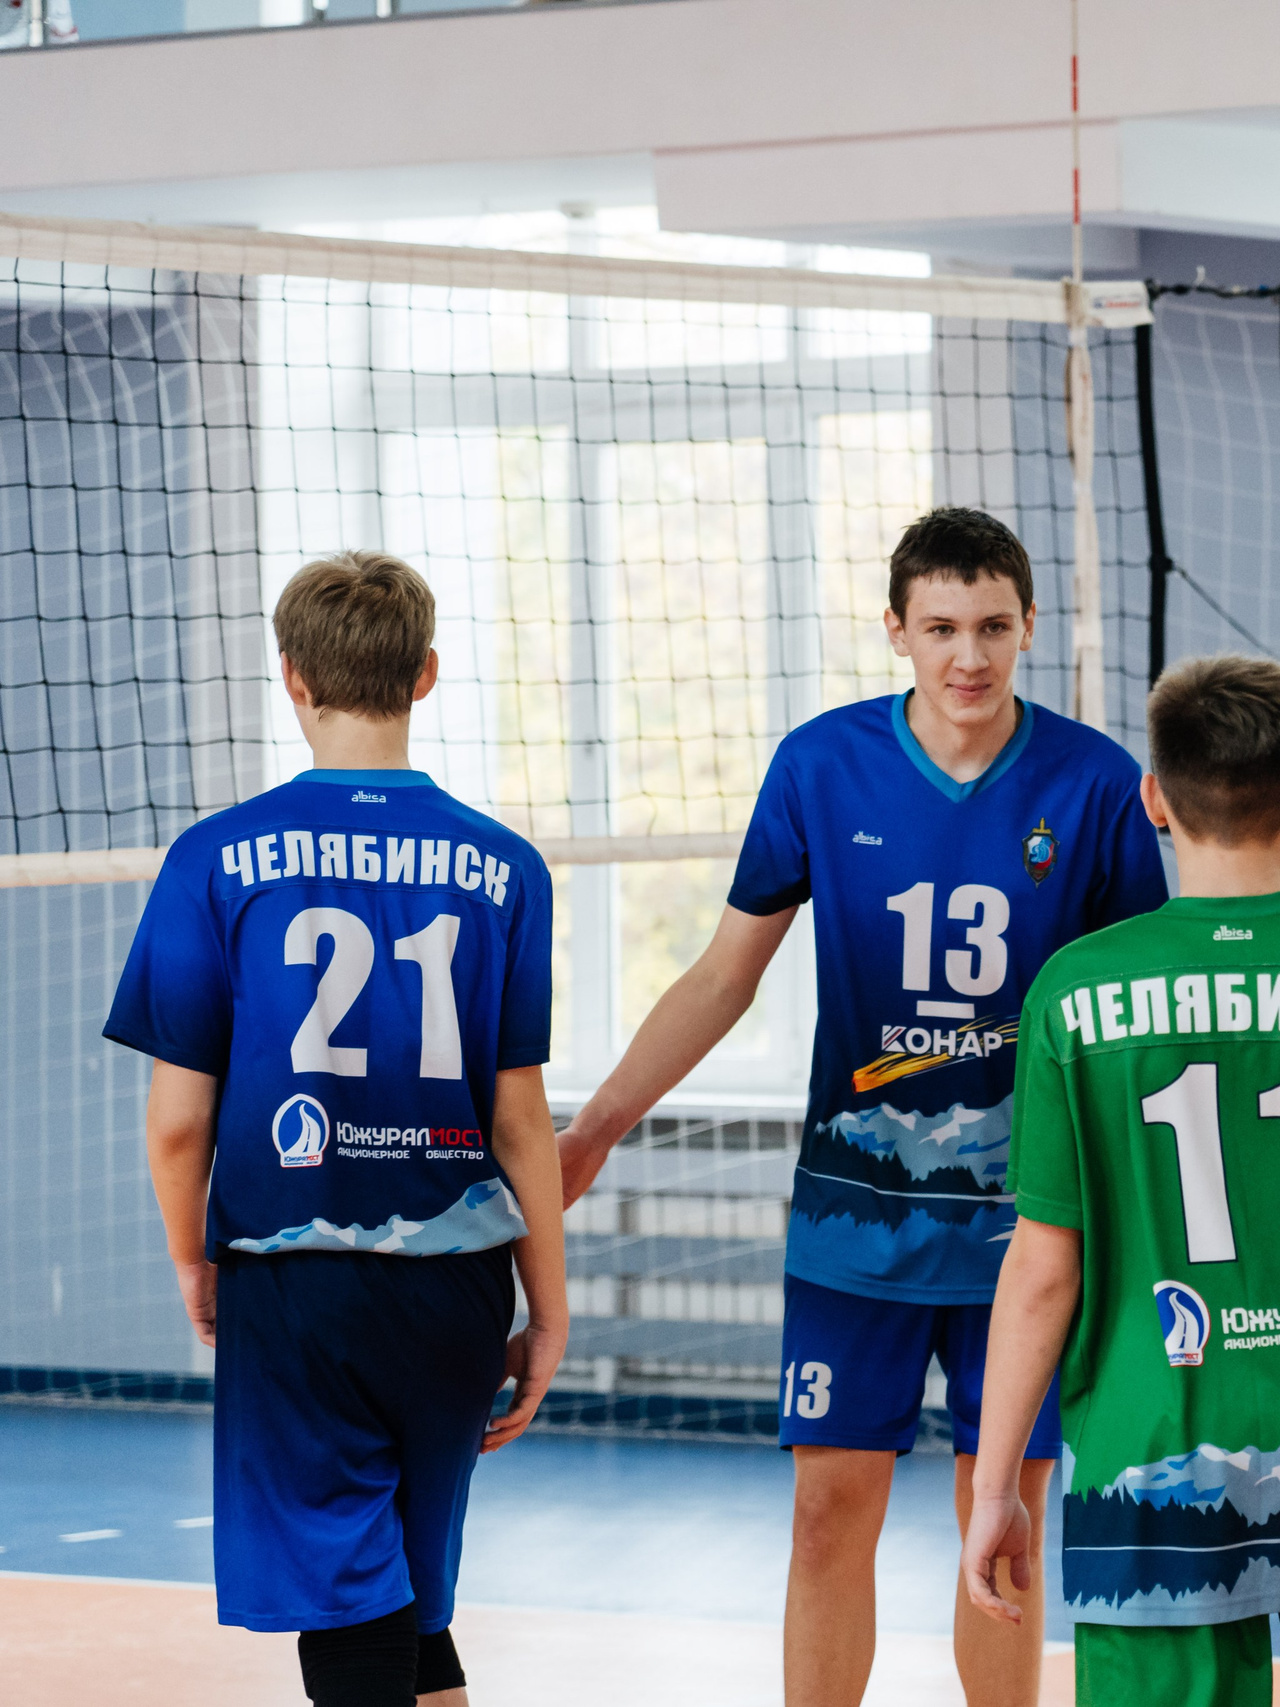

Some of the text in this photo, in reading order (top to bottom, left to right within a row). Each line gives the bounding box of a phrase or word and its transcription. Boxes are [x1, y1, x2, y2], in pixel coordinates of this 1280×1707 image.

[221, 830, 511, 907] ЧЕЛЯБИНСК
[887, 882, 1010, 996] 13
[284, 907, 462, 1080] 21
[881, 1025, 1003, 1058] КОНАР
[337, 1147, 411, 1160] АКЦИОНЕРНОЕ
[425, 1149, 485, 1161] ОБЩЕСТВО
[783, 1361, 833, 1419] 13
